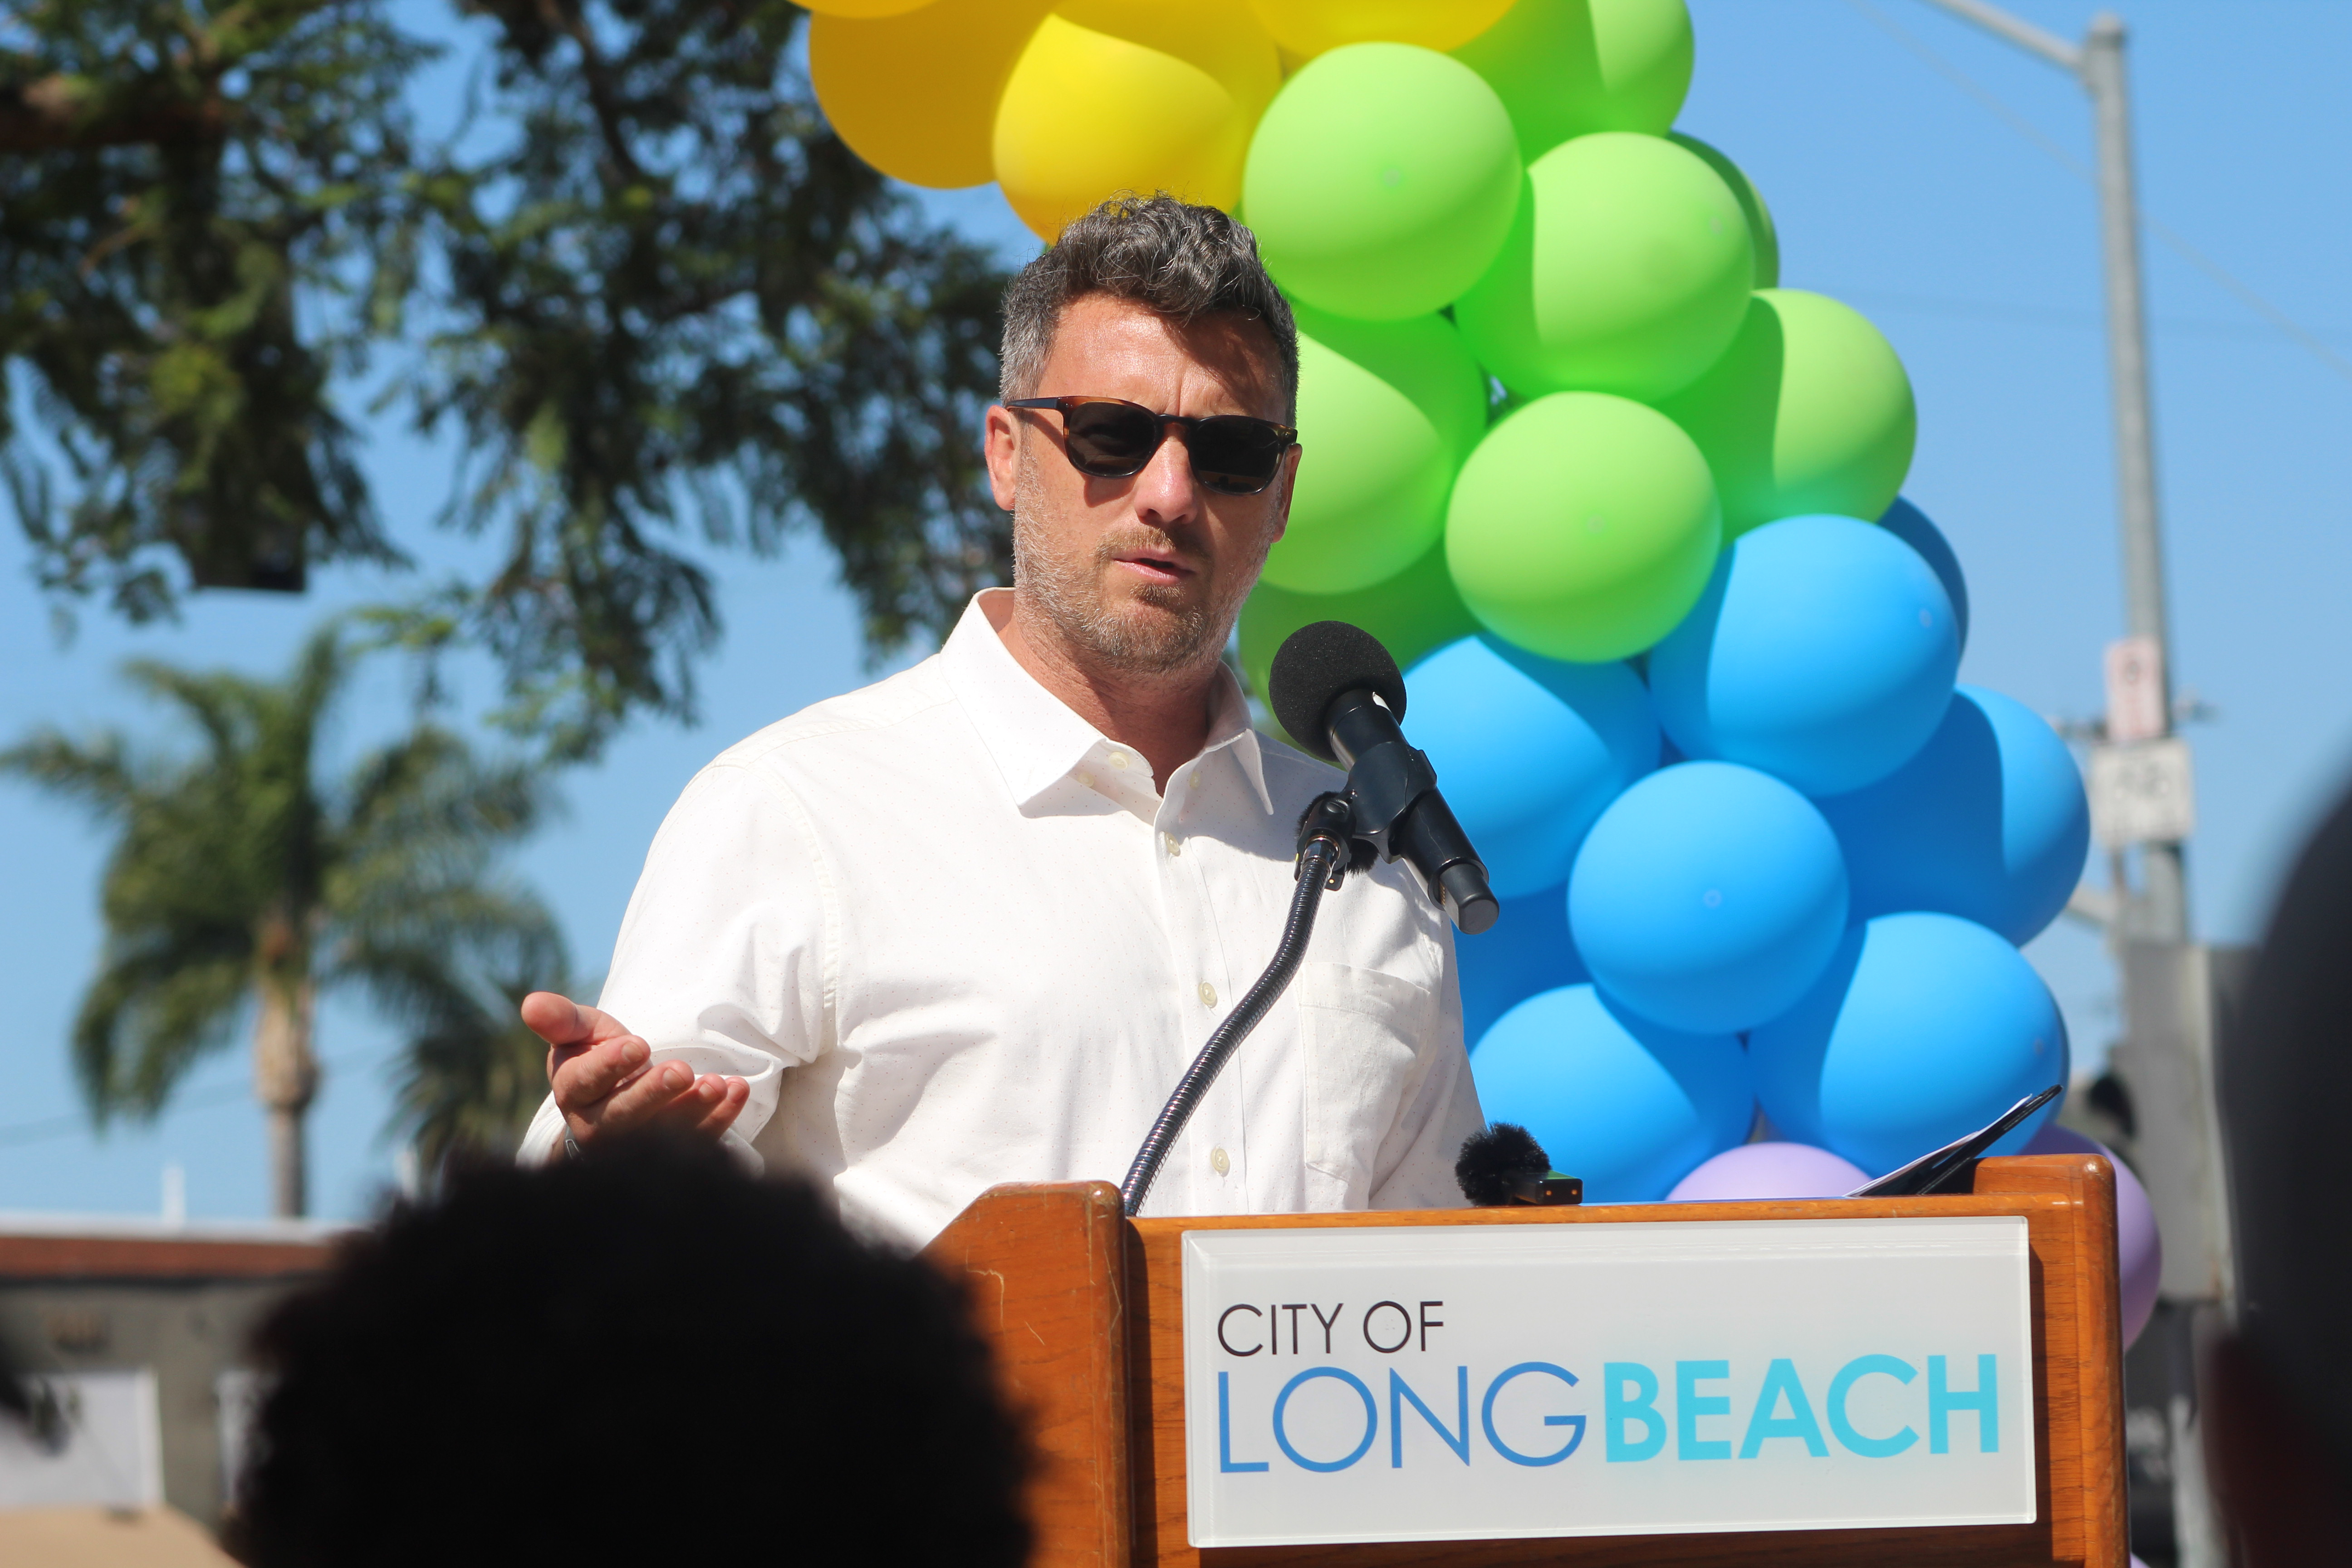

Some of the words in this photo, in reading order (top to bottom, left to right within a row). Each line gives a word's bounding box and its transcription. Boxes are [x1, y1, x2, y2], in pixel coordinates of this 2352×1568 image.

[1218, 1303, 1343, 1356] CITY
[1363, 1301, 1443, 1353] OF
[1219, 1362, 1587, 1473] LONG
[1604, 1354, 1999, 1462] BEACH
